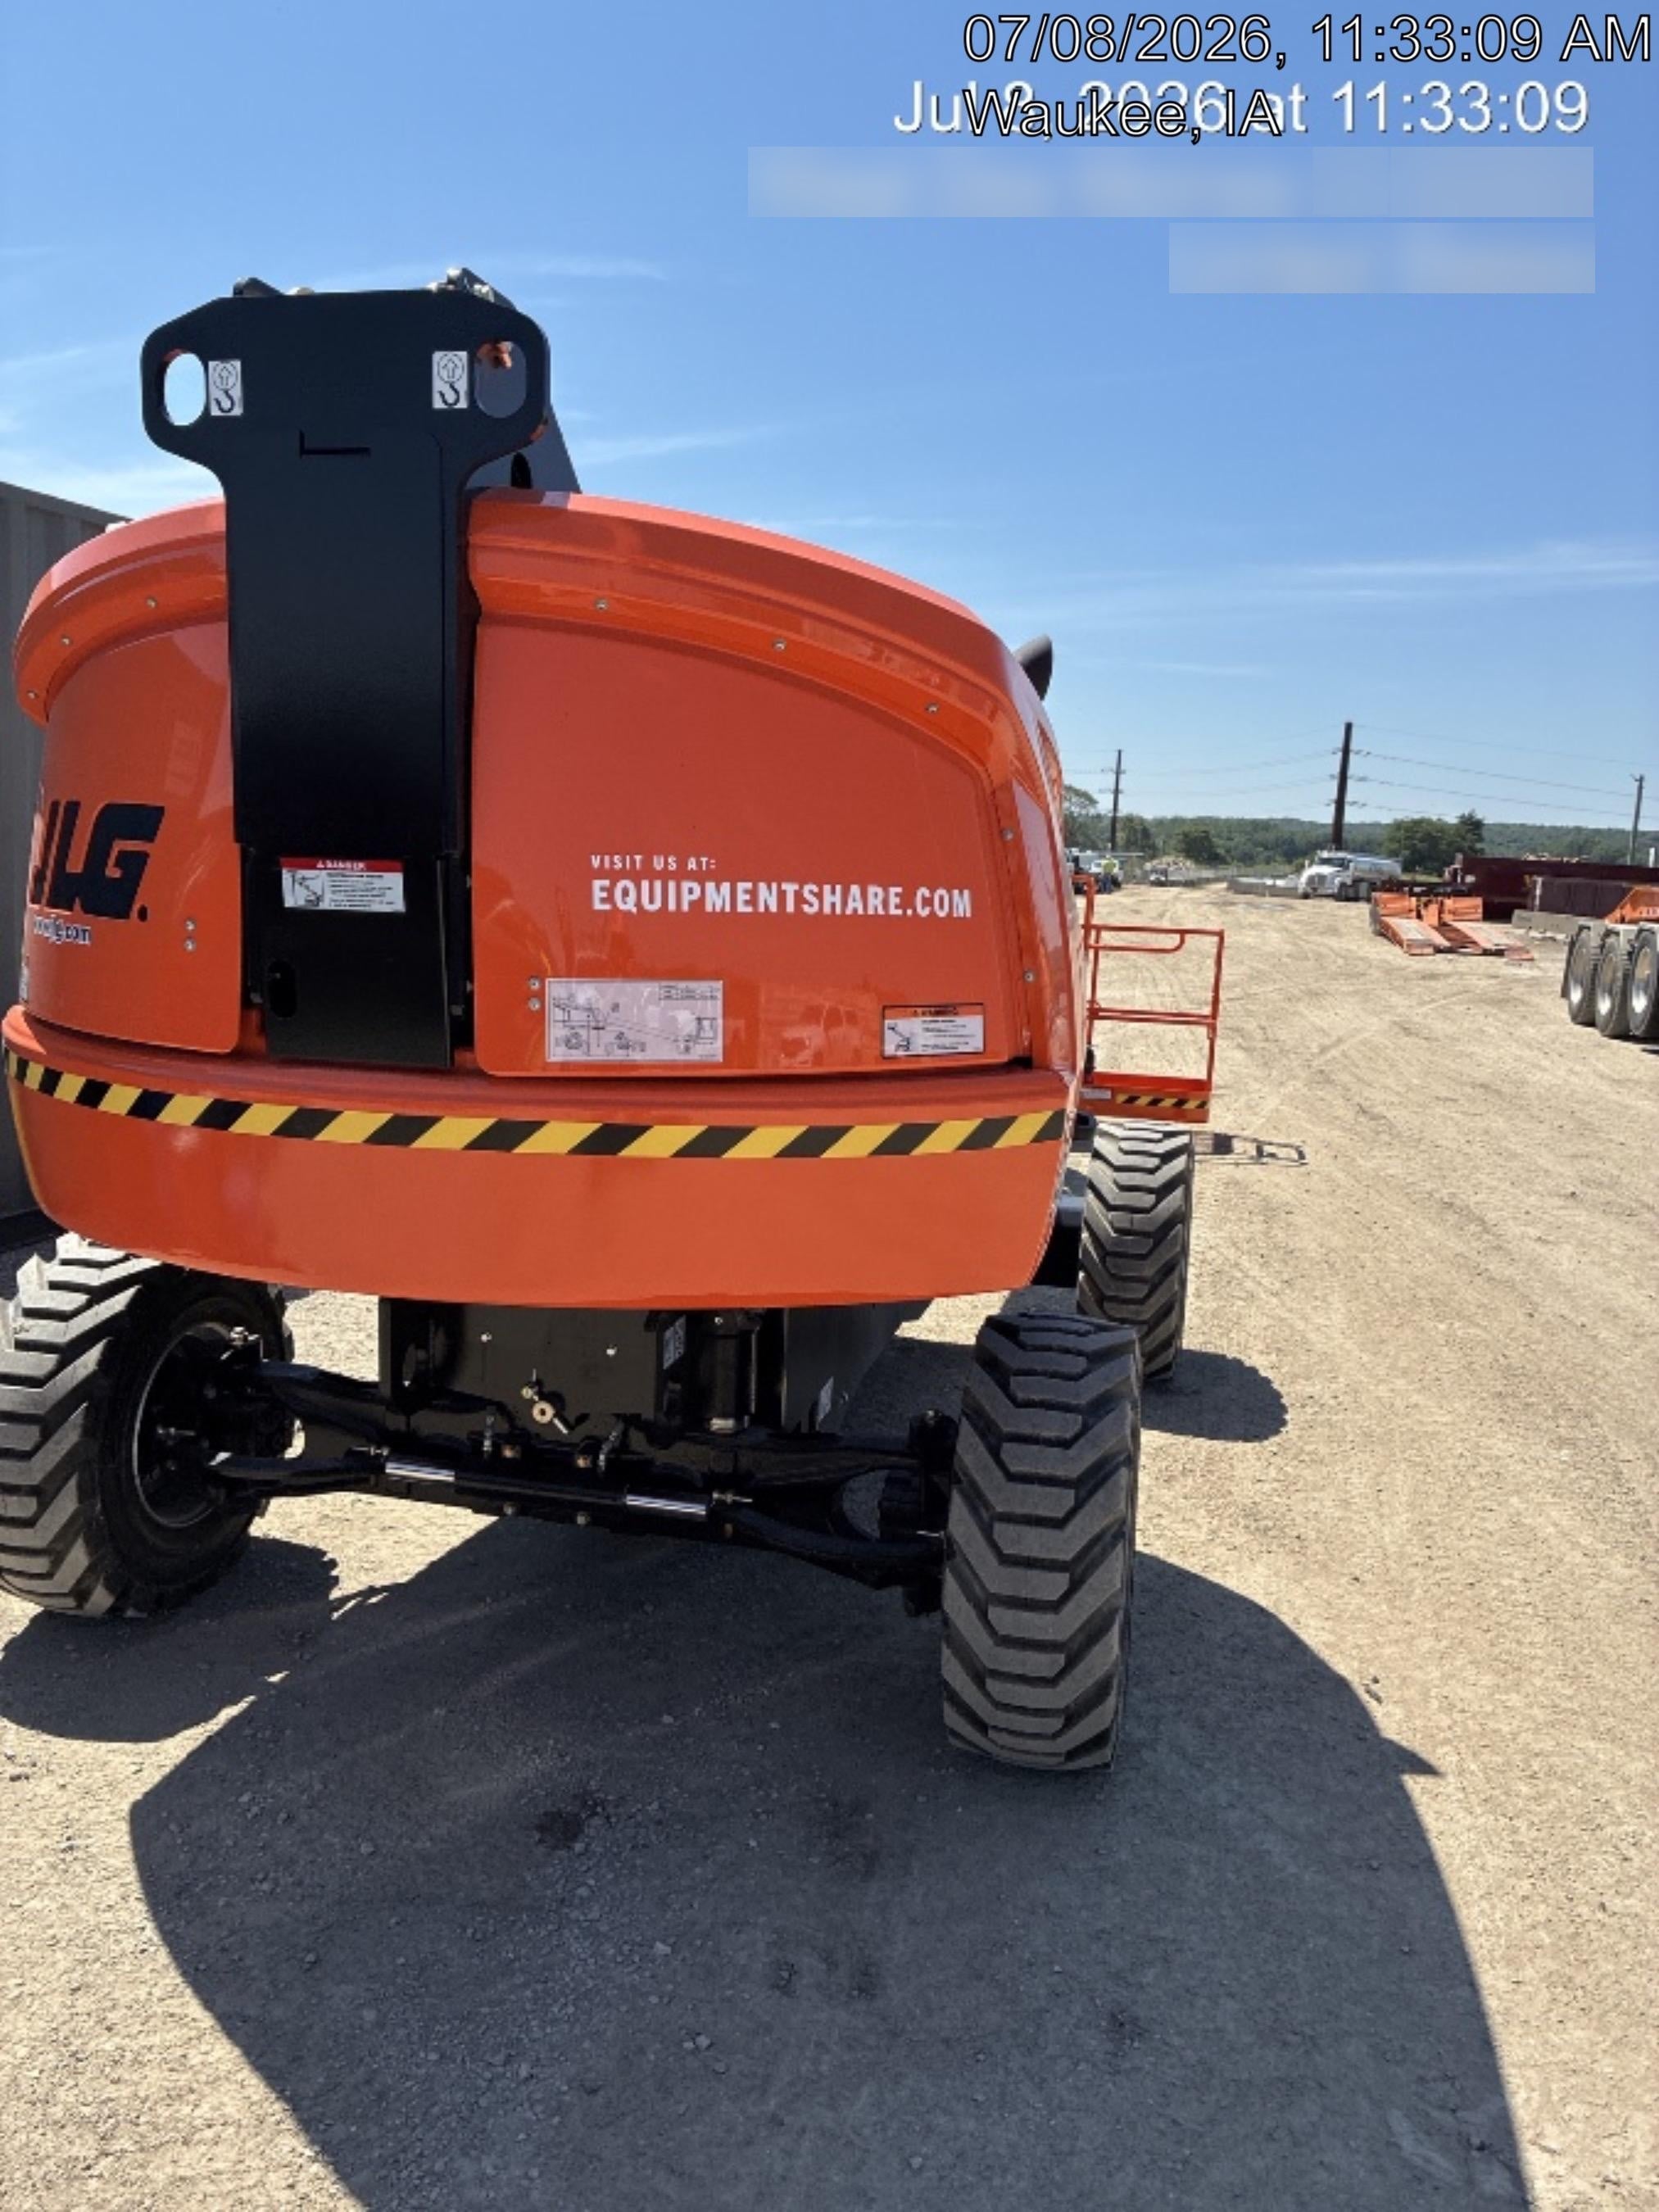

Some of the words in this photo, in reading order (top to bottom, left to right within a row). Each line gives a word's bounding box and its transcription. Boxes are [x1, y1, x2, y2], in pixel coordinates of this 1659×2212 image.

[591, 854, 643, 870] VISIT
[653, 855, 678, 871] US
[687, 856, 715, 871] AT:
[592, 878, 972, 918] EQUIPMENTSHARE.COM
